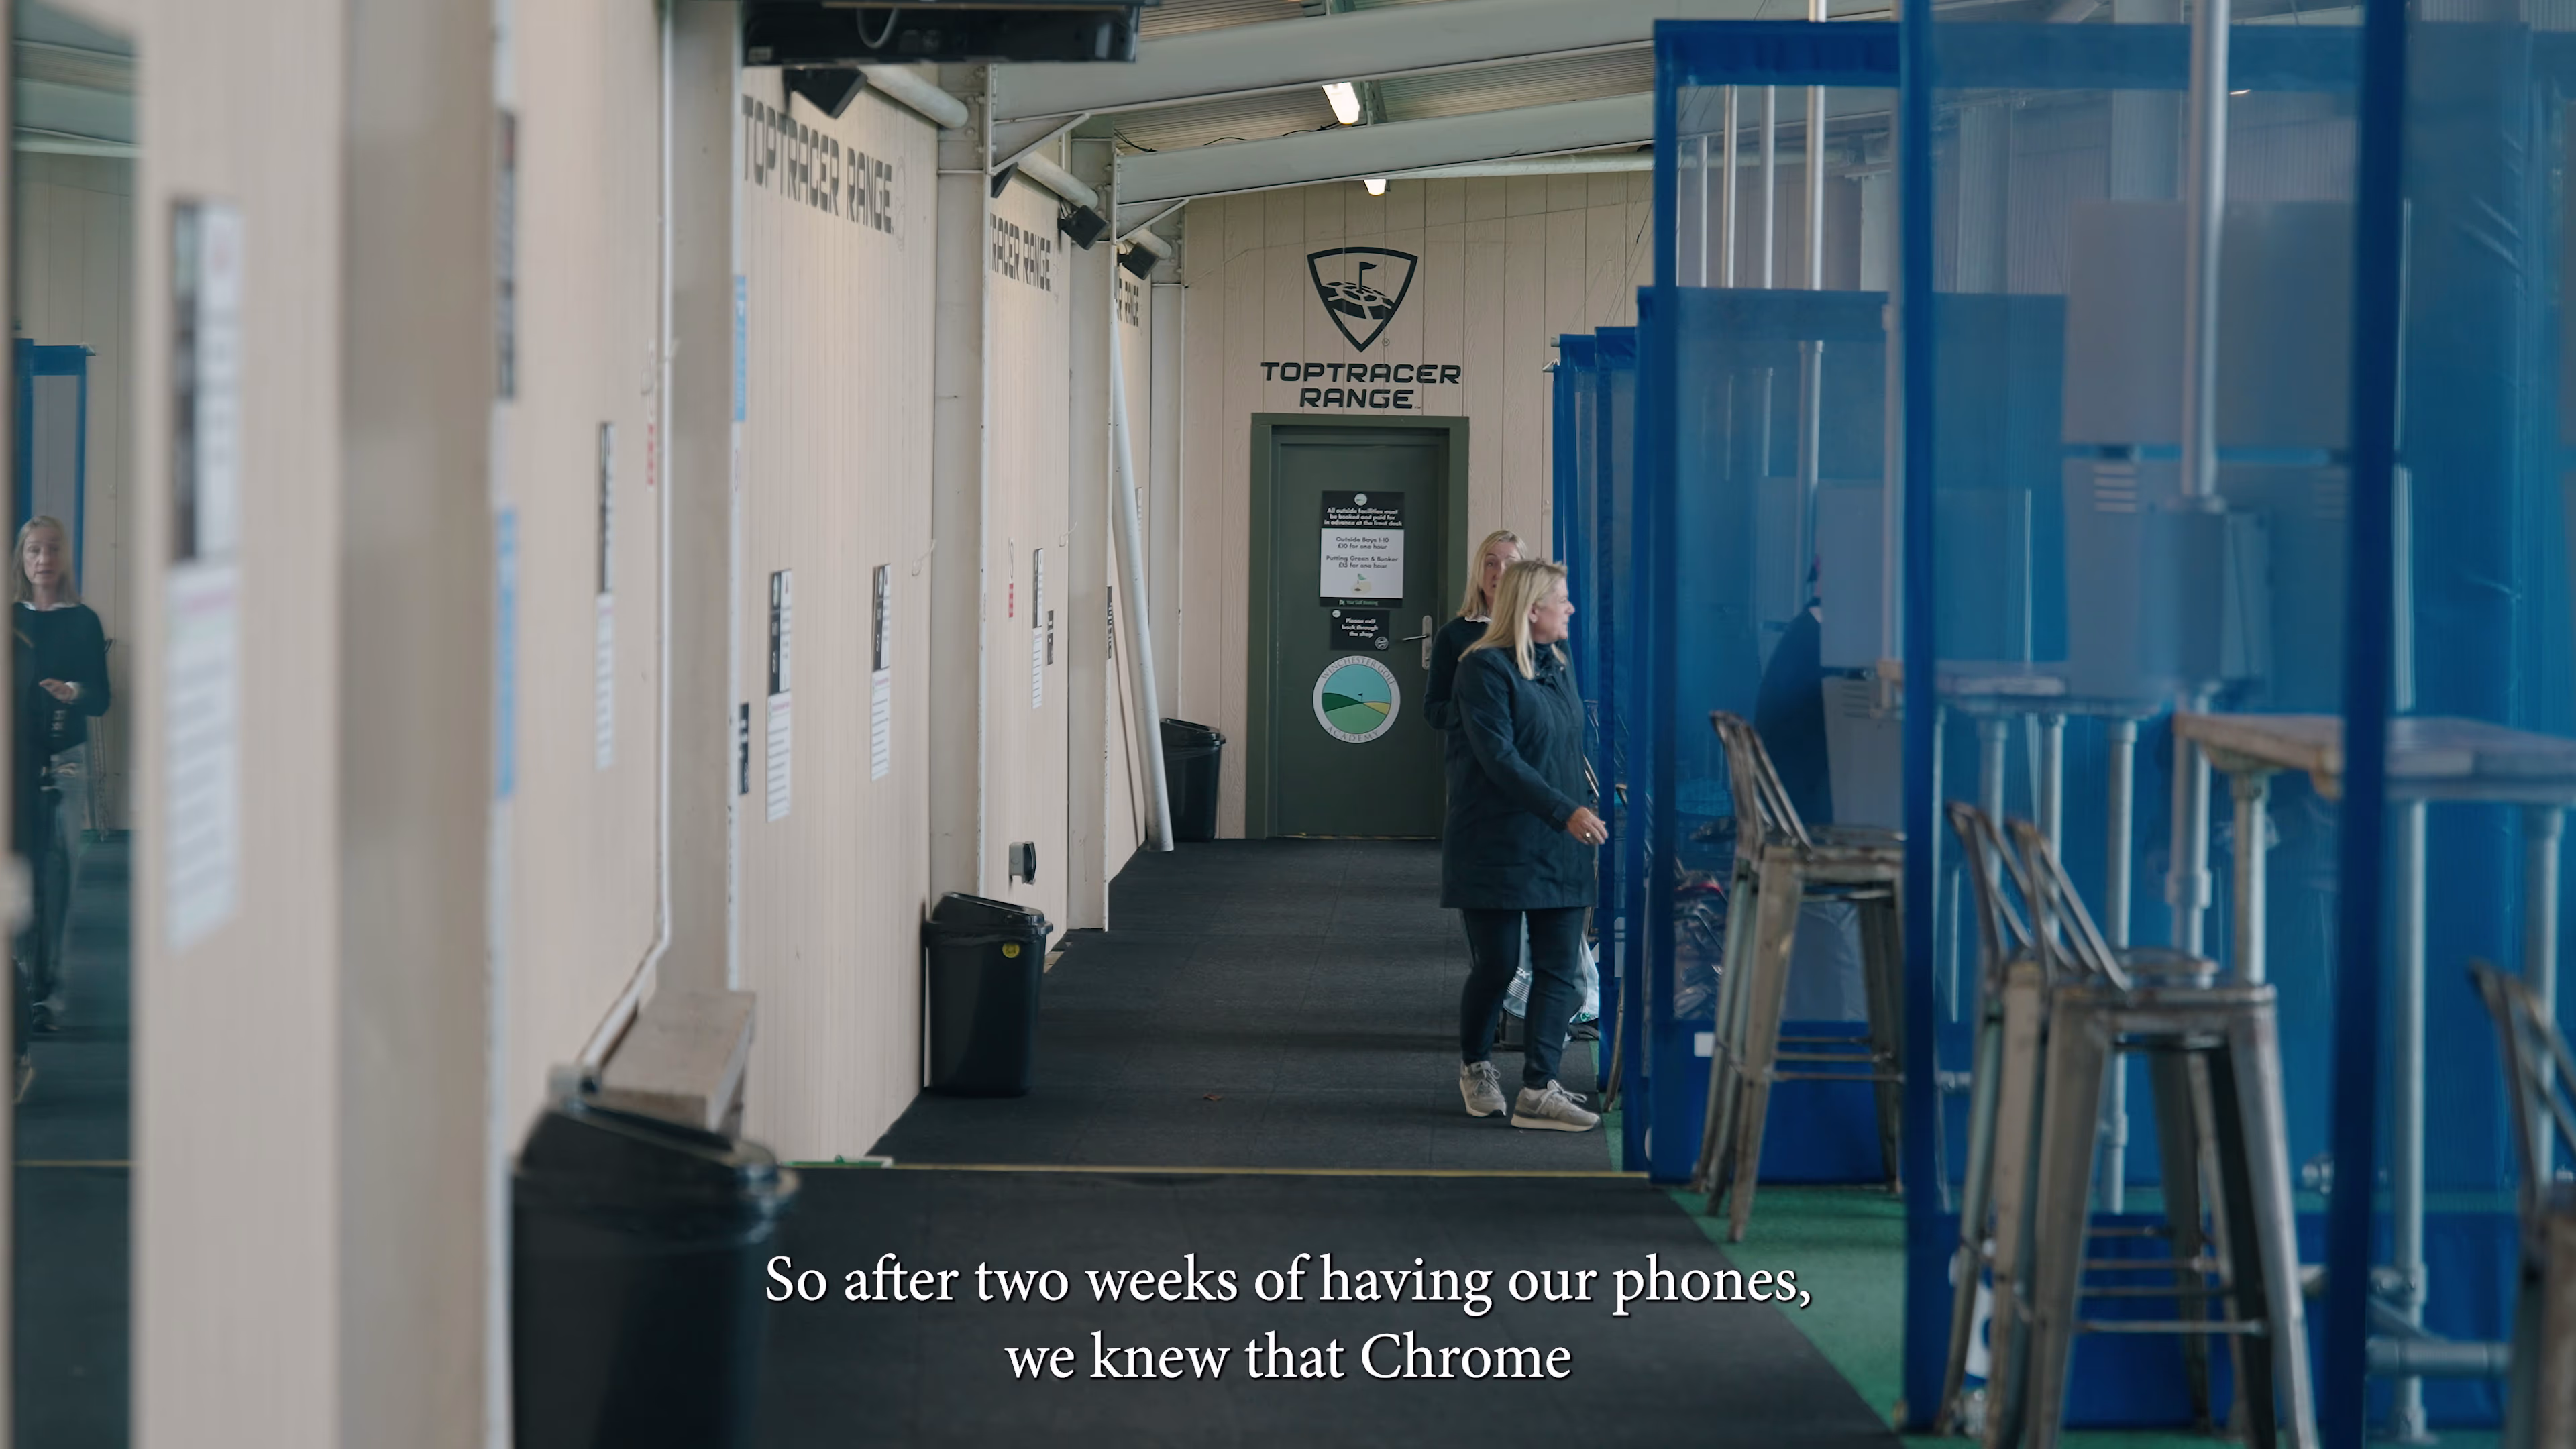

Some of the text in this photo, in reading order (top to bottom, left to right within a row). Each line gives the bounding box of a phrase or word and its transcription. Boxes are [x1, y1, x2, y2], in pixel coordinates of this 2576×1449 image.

[741, 94, 892, 233] TOPTRACER RANGE
[1023, 230, 1051, 291] RANGE
[1260, 362, 1461, 384] TOPTRACER
[1299, 388, 1414, 409] RANGE
[1322, 657, 1395, 686] WINCHESTER GOLF
[1327, 725, 1379, 742] ACADEMY
